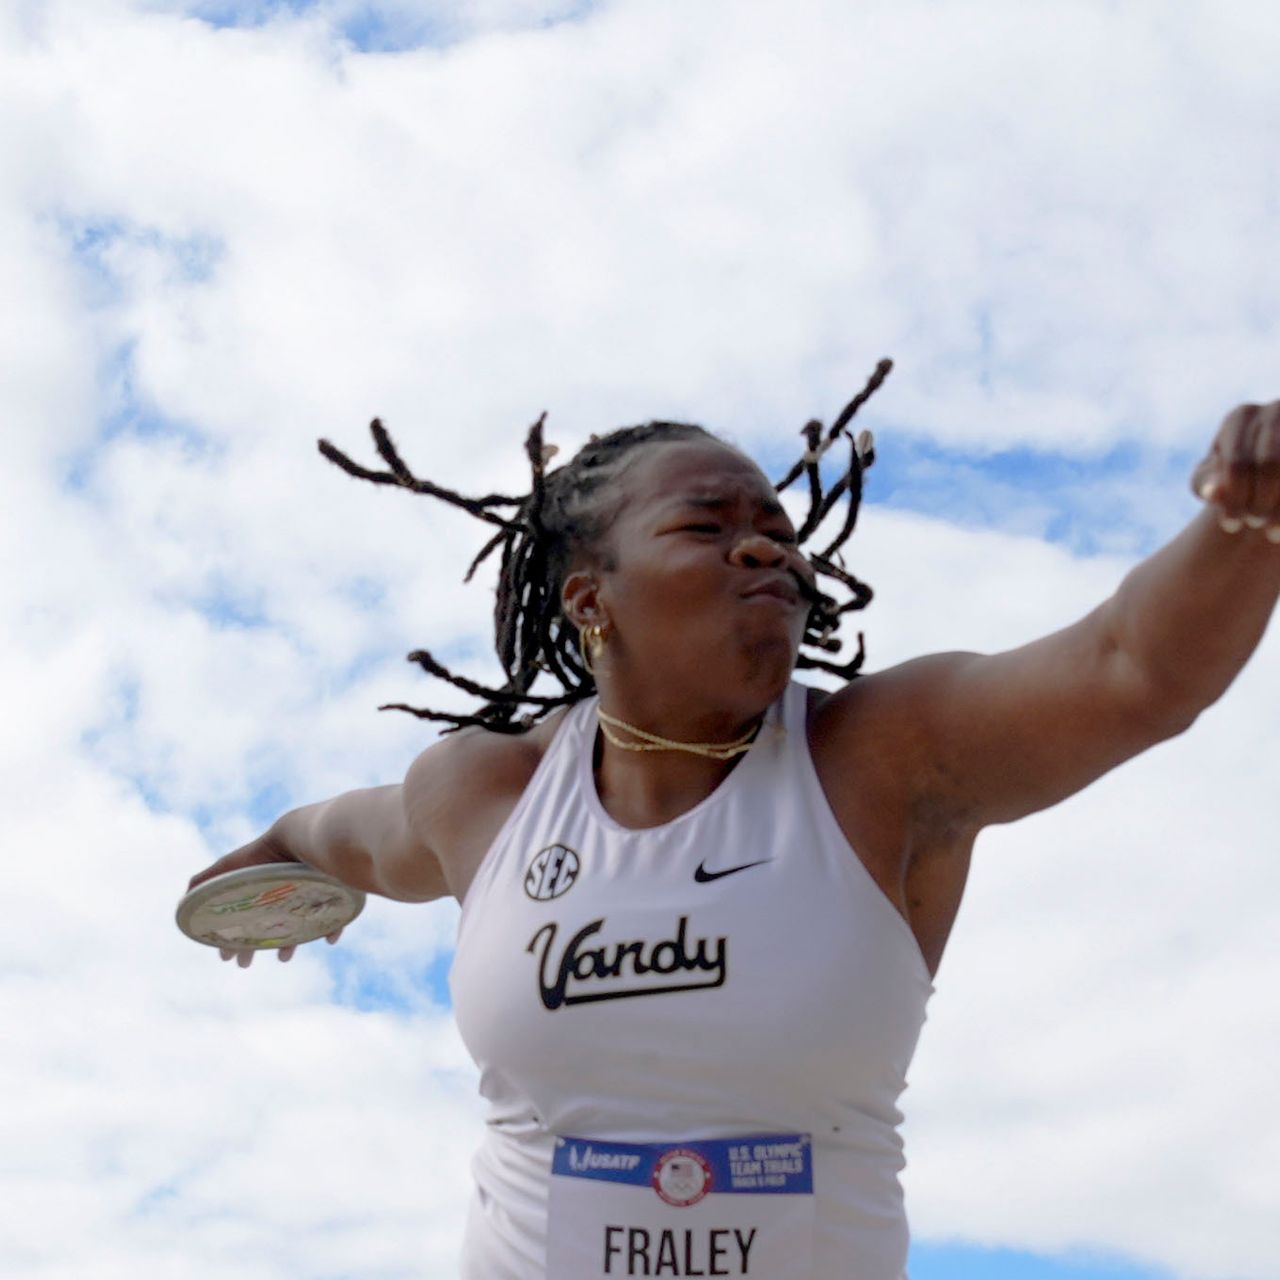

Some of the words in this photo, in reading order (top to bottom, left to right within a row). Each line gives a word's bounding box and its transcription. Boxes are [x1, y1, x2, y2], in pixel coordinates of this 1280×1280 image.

[525, 844, 580, 901] SEC
[526, 916, 727, 1010] Vandy
[592, 1152, 641, 1171] USATF
[604, 1226, 757, 1276] FRALEY
